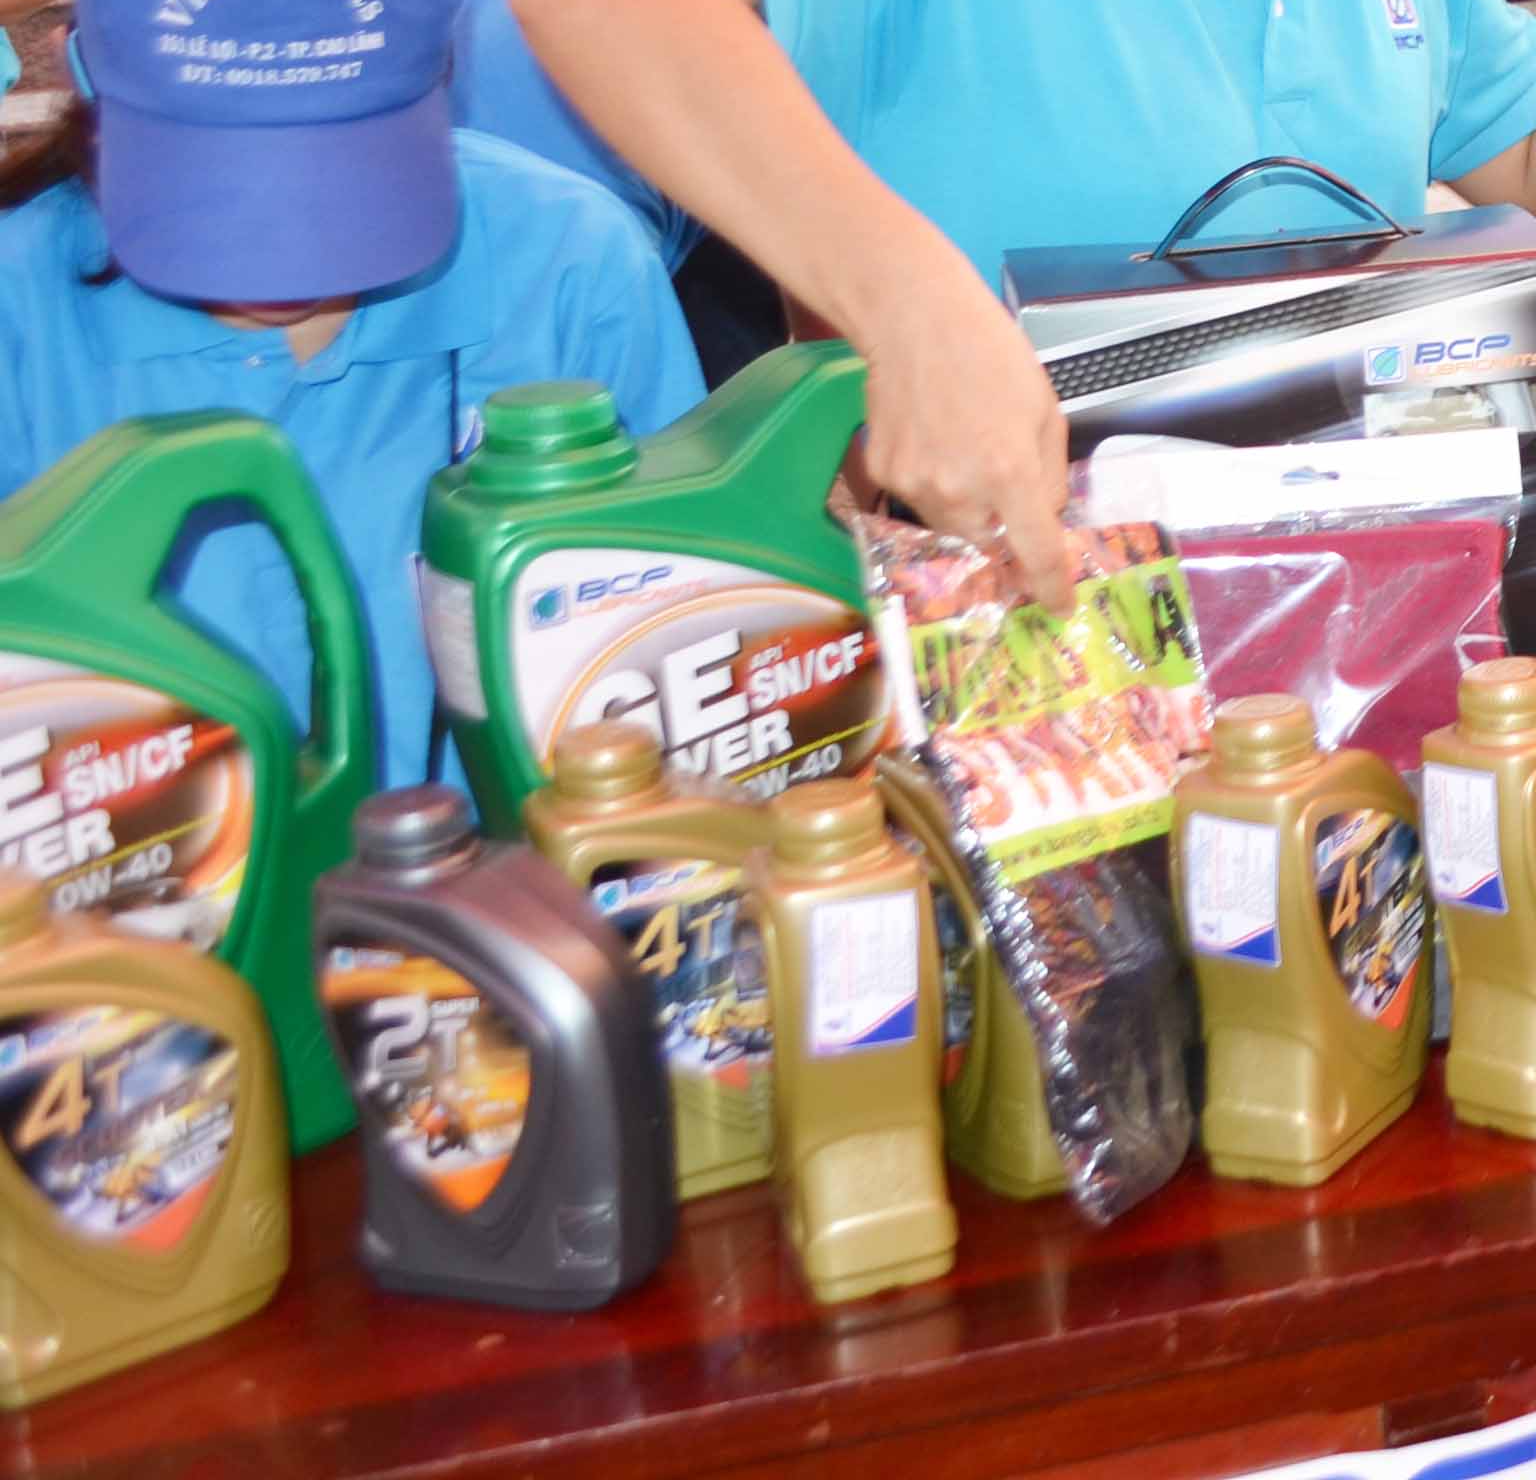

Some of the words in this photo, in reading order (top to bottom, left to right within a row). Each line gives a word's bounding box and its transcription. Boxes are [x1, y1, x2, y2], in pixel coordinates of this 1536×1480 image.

[1413, 332, 1512, 365] BCP
[576, 565, 674, 603] BCP
[748, 631, 866, 710] SN/CF
[63, 723, 193, 810] SN/CF
[1328, 856, 1378, 938] 4T
